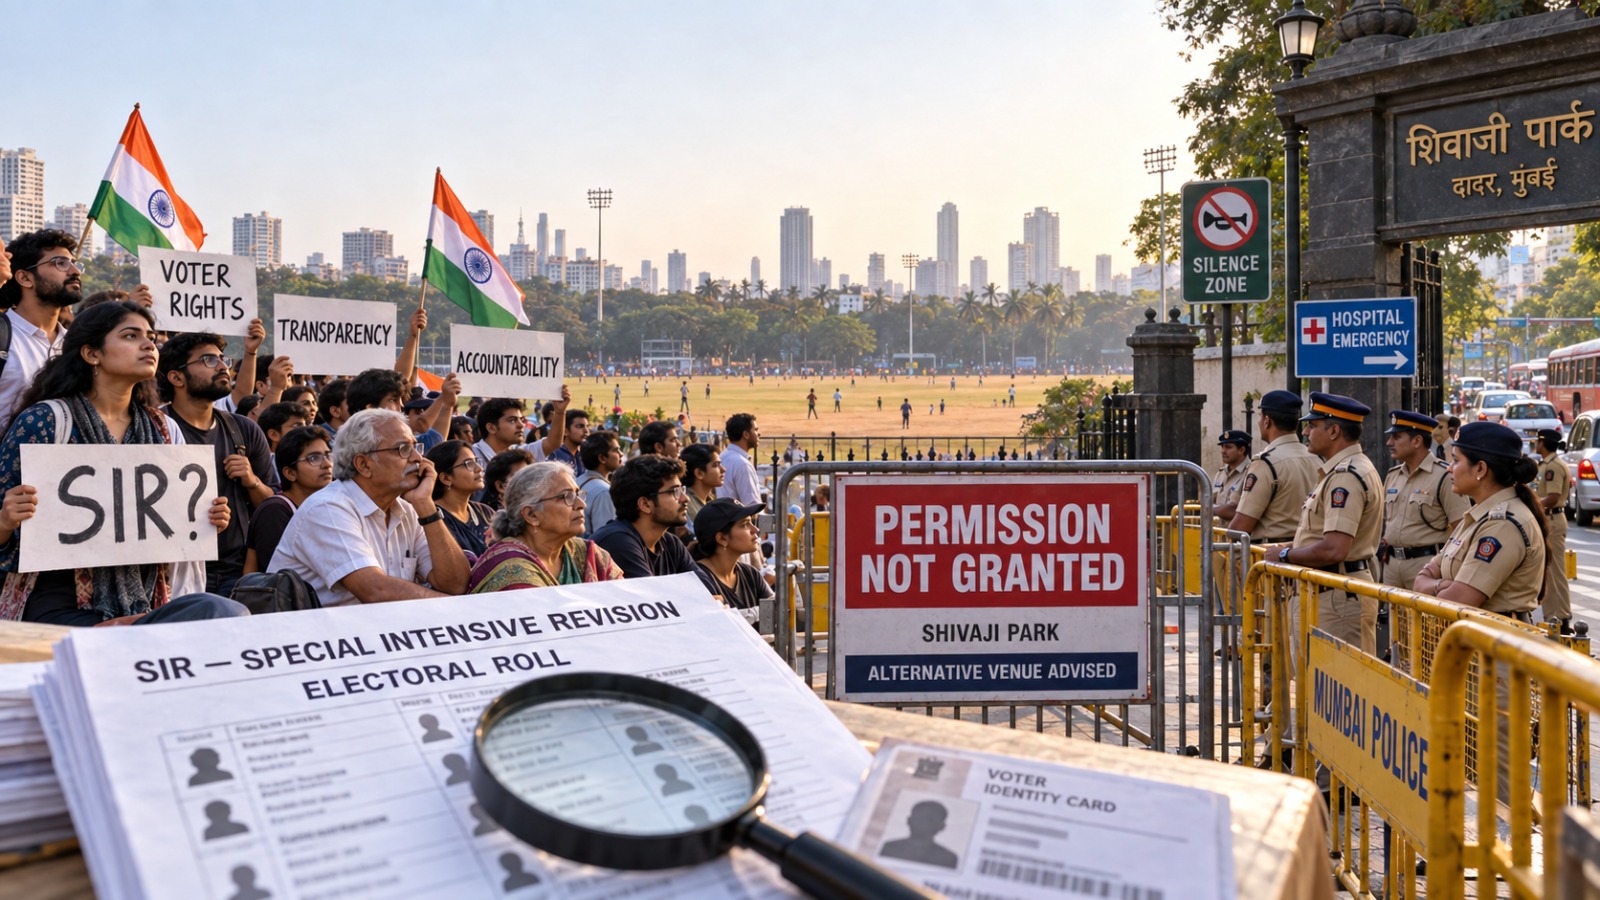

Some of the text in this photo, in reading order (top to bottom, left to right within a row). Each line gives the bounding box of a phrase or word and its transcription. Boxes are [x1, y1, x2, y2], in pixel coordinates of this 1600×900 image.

[1406, 100, 1595, 166] शिवाजी पार्क
[1451, 157, 1558, 198] दादर, मुंबई
[160, 259, 231, 288] VOTER
[1193, 255, 1259, 274] SILENCE
[1205, 276, 1247, 294] ZONE
[170, 291, 245, 320] RIGHTS
[1332, 309, 1404, 327] HOSPITAL
[277, 318, 392, 347] TRANSPARENCY
[1332, 330, 1410, 348] EMERGENCY
[456, 350, 559, 378] ACCOUNTABILITY
[57, 463, 208, 545] SIR?
[875, 503, 1110, 545] PERMISSION
[861, 553, 1125, 593] NOT GRANTED
[134, 655, 195, 683] SIR
[240, 635, 376, 672] SPECIAL
[380, 616, 542, 651] INTENSIVE
[547, 600, 681, 631] REVISION
[922, 623, 1060, 642] SHIVAJI PARK
[302, 656, 487, 701] ELECTORAL
[492, 648, 571, 674] ROLL
[868, 662, 1117, 682] ALTERNATIVE VENUE ADVISED
[1313, 667, 1429, 802] MUMBAI POLICE
[988, 768, 1047, 788] VOTER
[984, 783, 1117, 813] IDENTITY CARD
